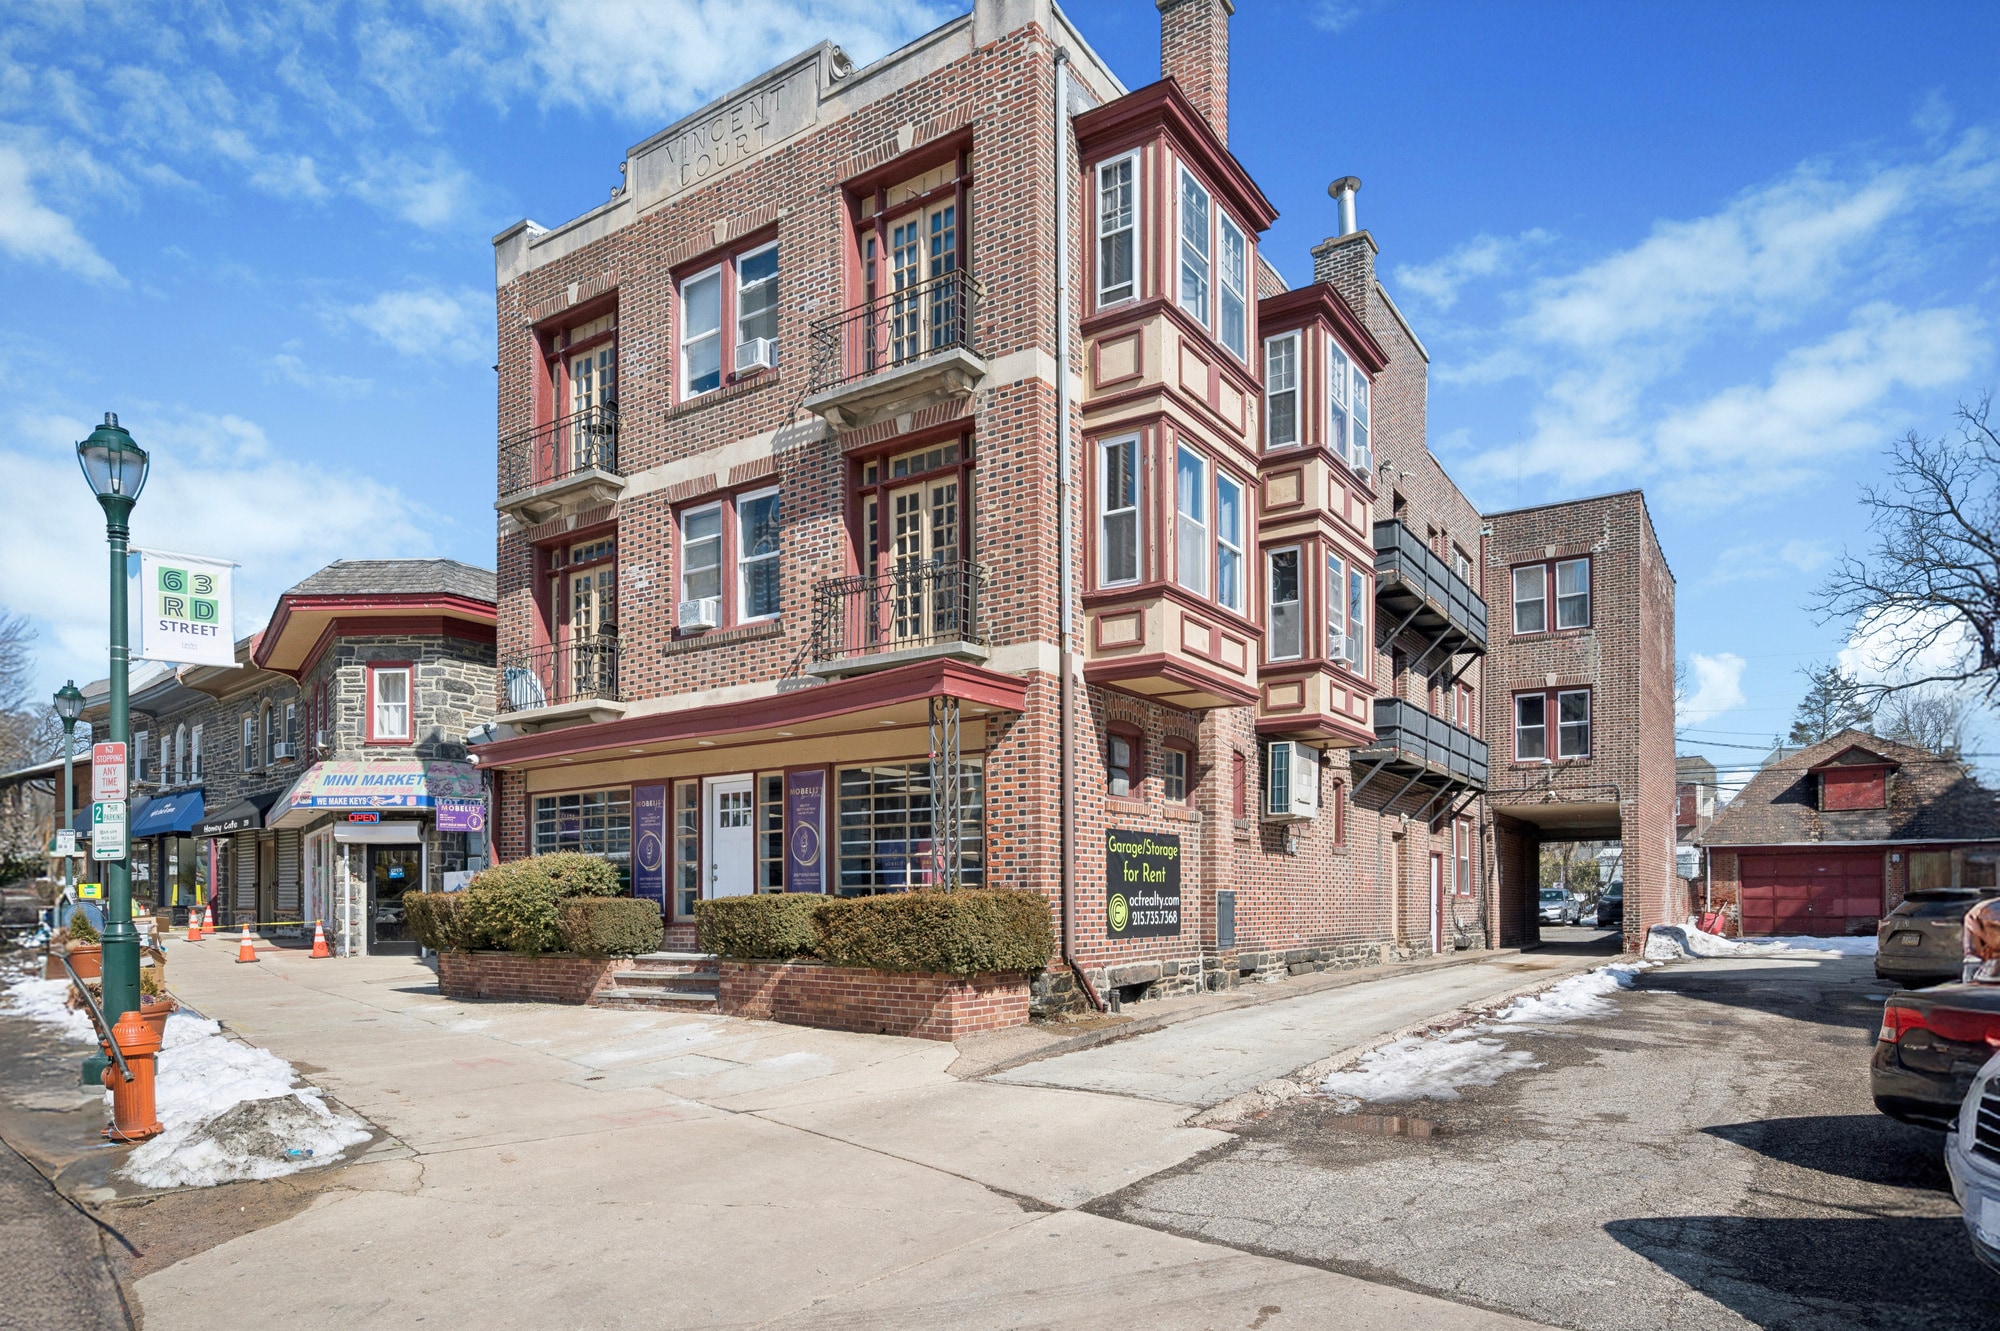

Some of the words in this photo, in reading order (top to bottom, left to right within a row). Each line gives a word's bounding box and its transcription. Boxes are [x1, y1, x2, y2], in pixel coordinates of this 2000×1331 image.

[665, 84, 785, 163] VINCENT
[680, 121, 769, 187] COURT
[159, 620, 219, 636] STREET
[105, 745, 114, 753] NO
[96, 754, 123, 763] STOPPING
[103, 766, 117, 776] ANY
[102, 777, 118, 787] TIME
[322, 774, 358, 786] MINI
[361, 774, 425, 786] MARKET
[316, 797, 327, 805] WE
[328, 797, 349, 805] MAKE
[349, 796, 367, 805] KEYS
[95, 806, 102, 821] 2
[349, 813, 377, 822] OPEN
[203, 824, 222, 834] Honey
[224, 820, 238, 830] Cafe
[1108, 835, 1179, 860] Garage/Storage
[1123, 861, 1139, 882] for
[1142, 862, 1166, 883] Rent
[1129, 890, 1180, 909] ocfrealty.com
[1132, 910, 1177, 926] 215.735.7368
